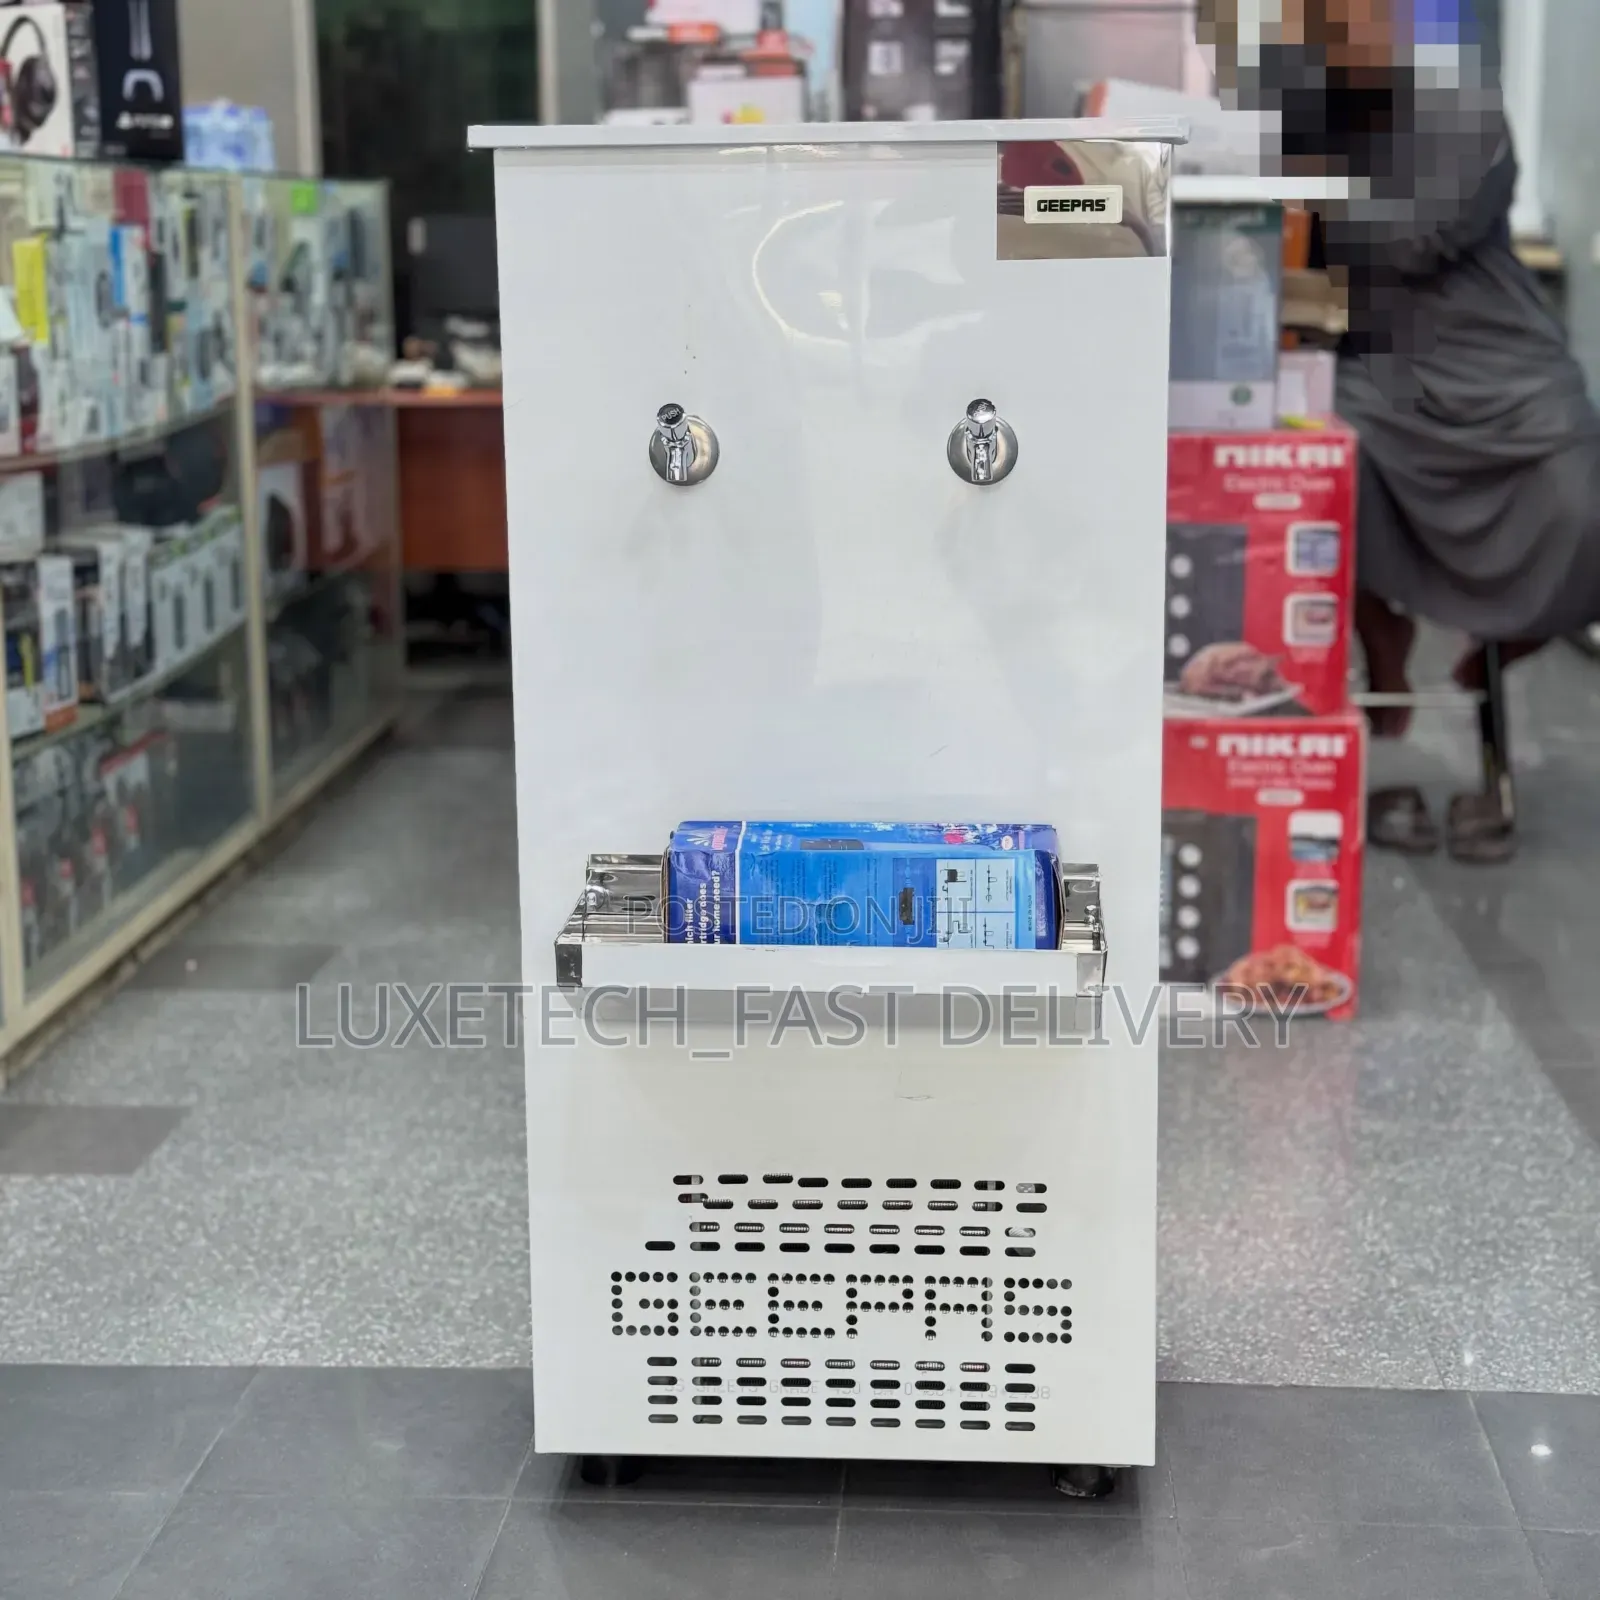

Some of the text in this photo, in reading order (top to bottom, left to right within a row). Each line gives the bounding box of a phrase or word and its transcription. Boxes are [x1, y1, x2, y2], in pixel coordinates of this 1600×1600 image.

[1036, 198, 1107, 213] GEEPAS
[710, 870, 721, 902] need?
[684, 898, 694, 944] hich filter
[698, 882, 709, 944] rtridge does
[711, 904, 721, 932] home
[610, 1271, 1073, 1344] GEEPAS
